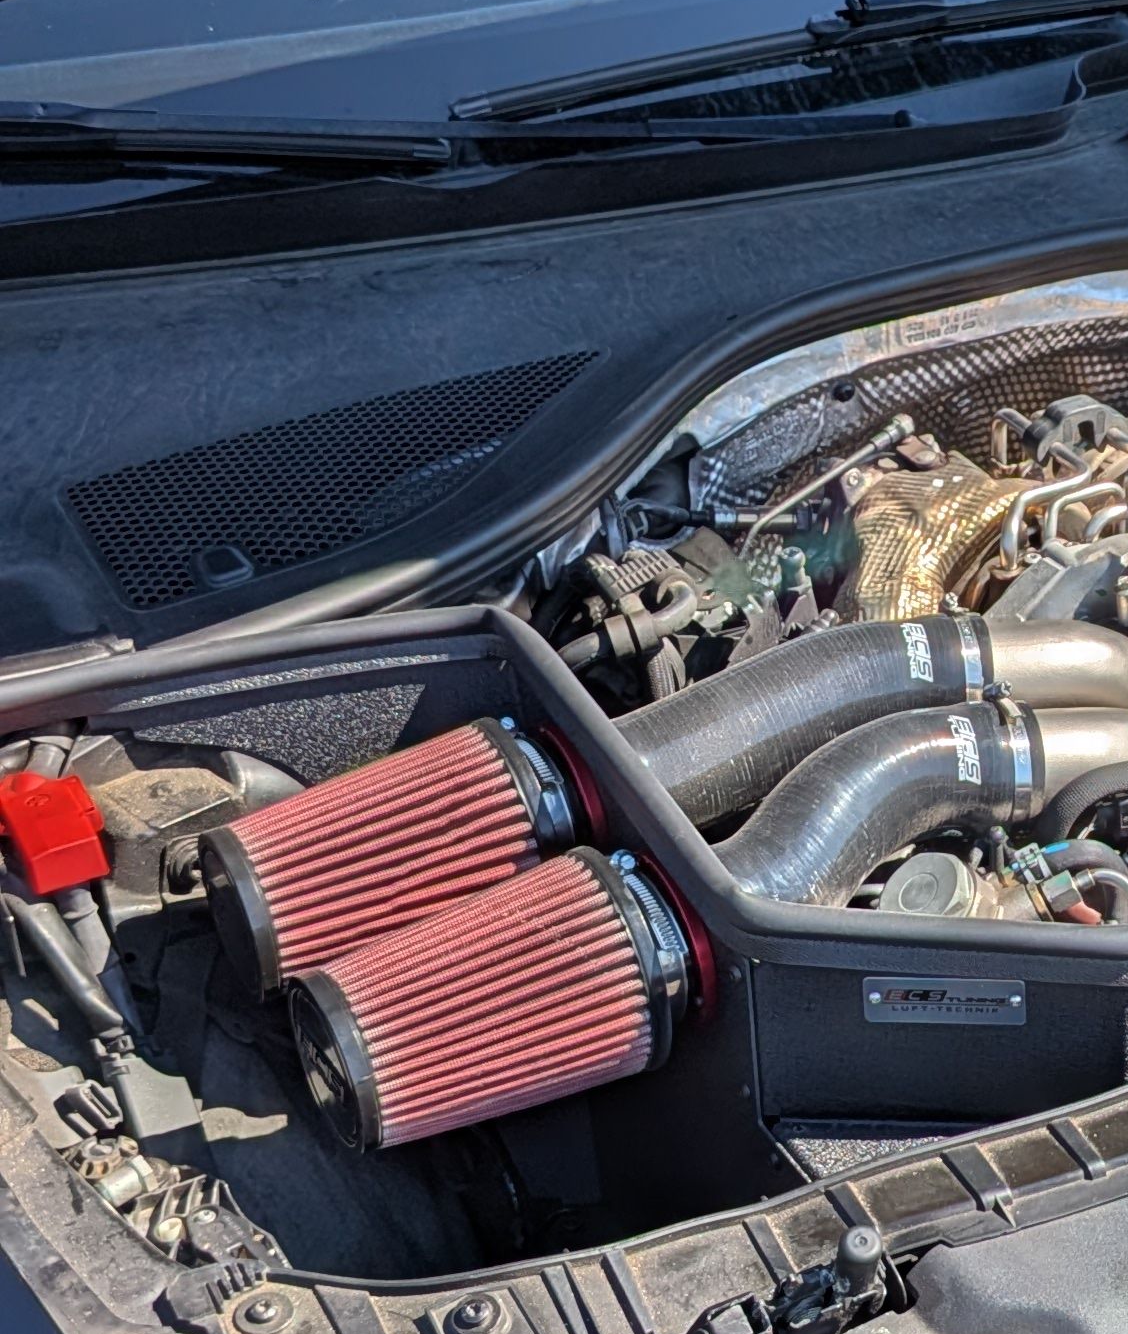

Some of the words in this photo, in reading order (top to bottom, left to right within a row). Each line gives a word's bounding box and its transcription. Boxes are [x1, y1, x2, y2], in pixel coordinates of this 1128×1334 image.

[907, 623, 934, 683] ECS
[952, 715, 981, 785] ECS
[885, 989, 945, 1003] ECS
[892, 1005, 999, 1014] LUFT-TECHNIK
